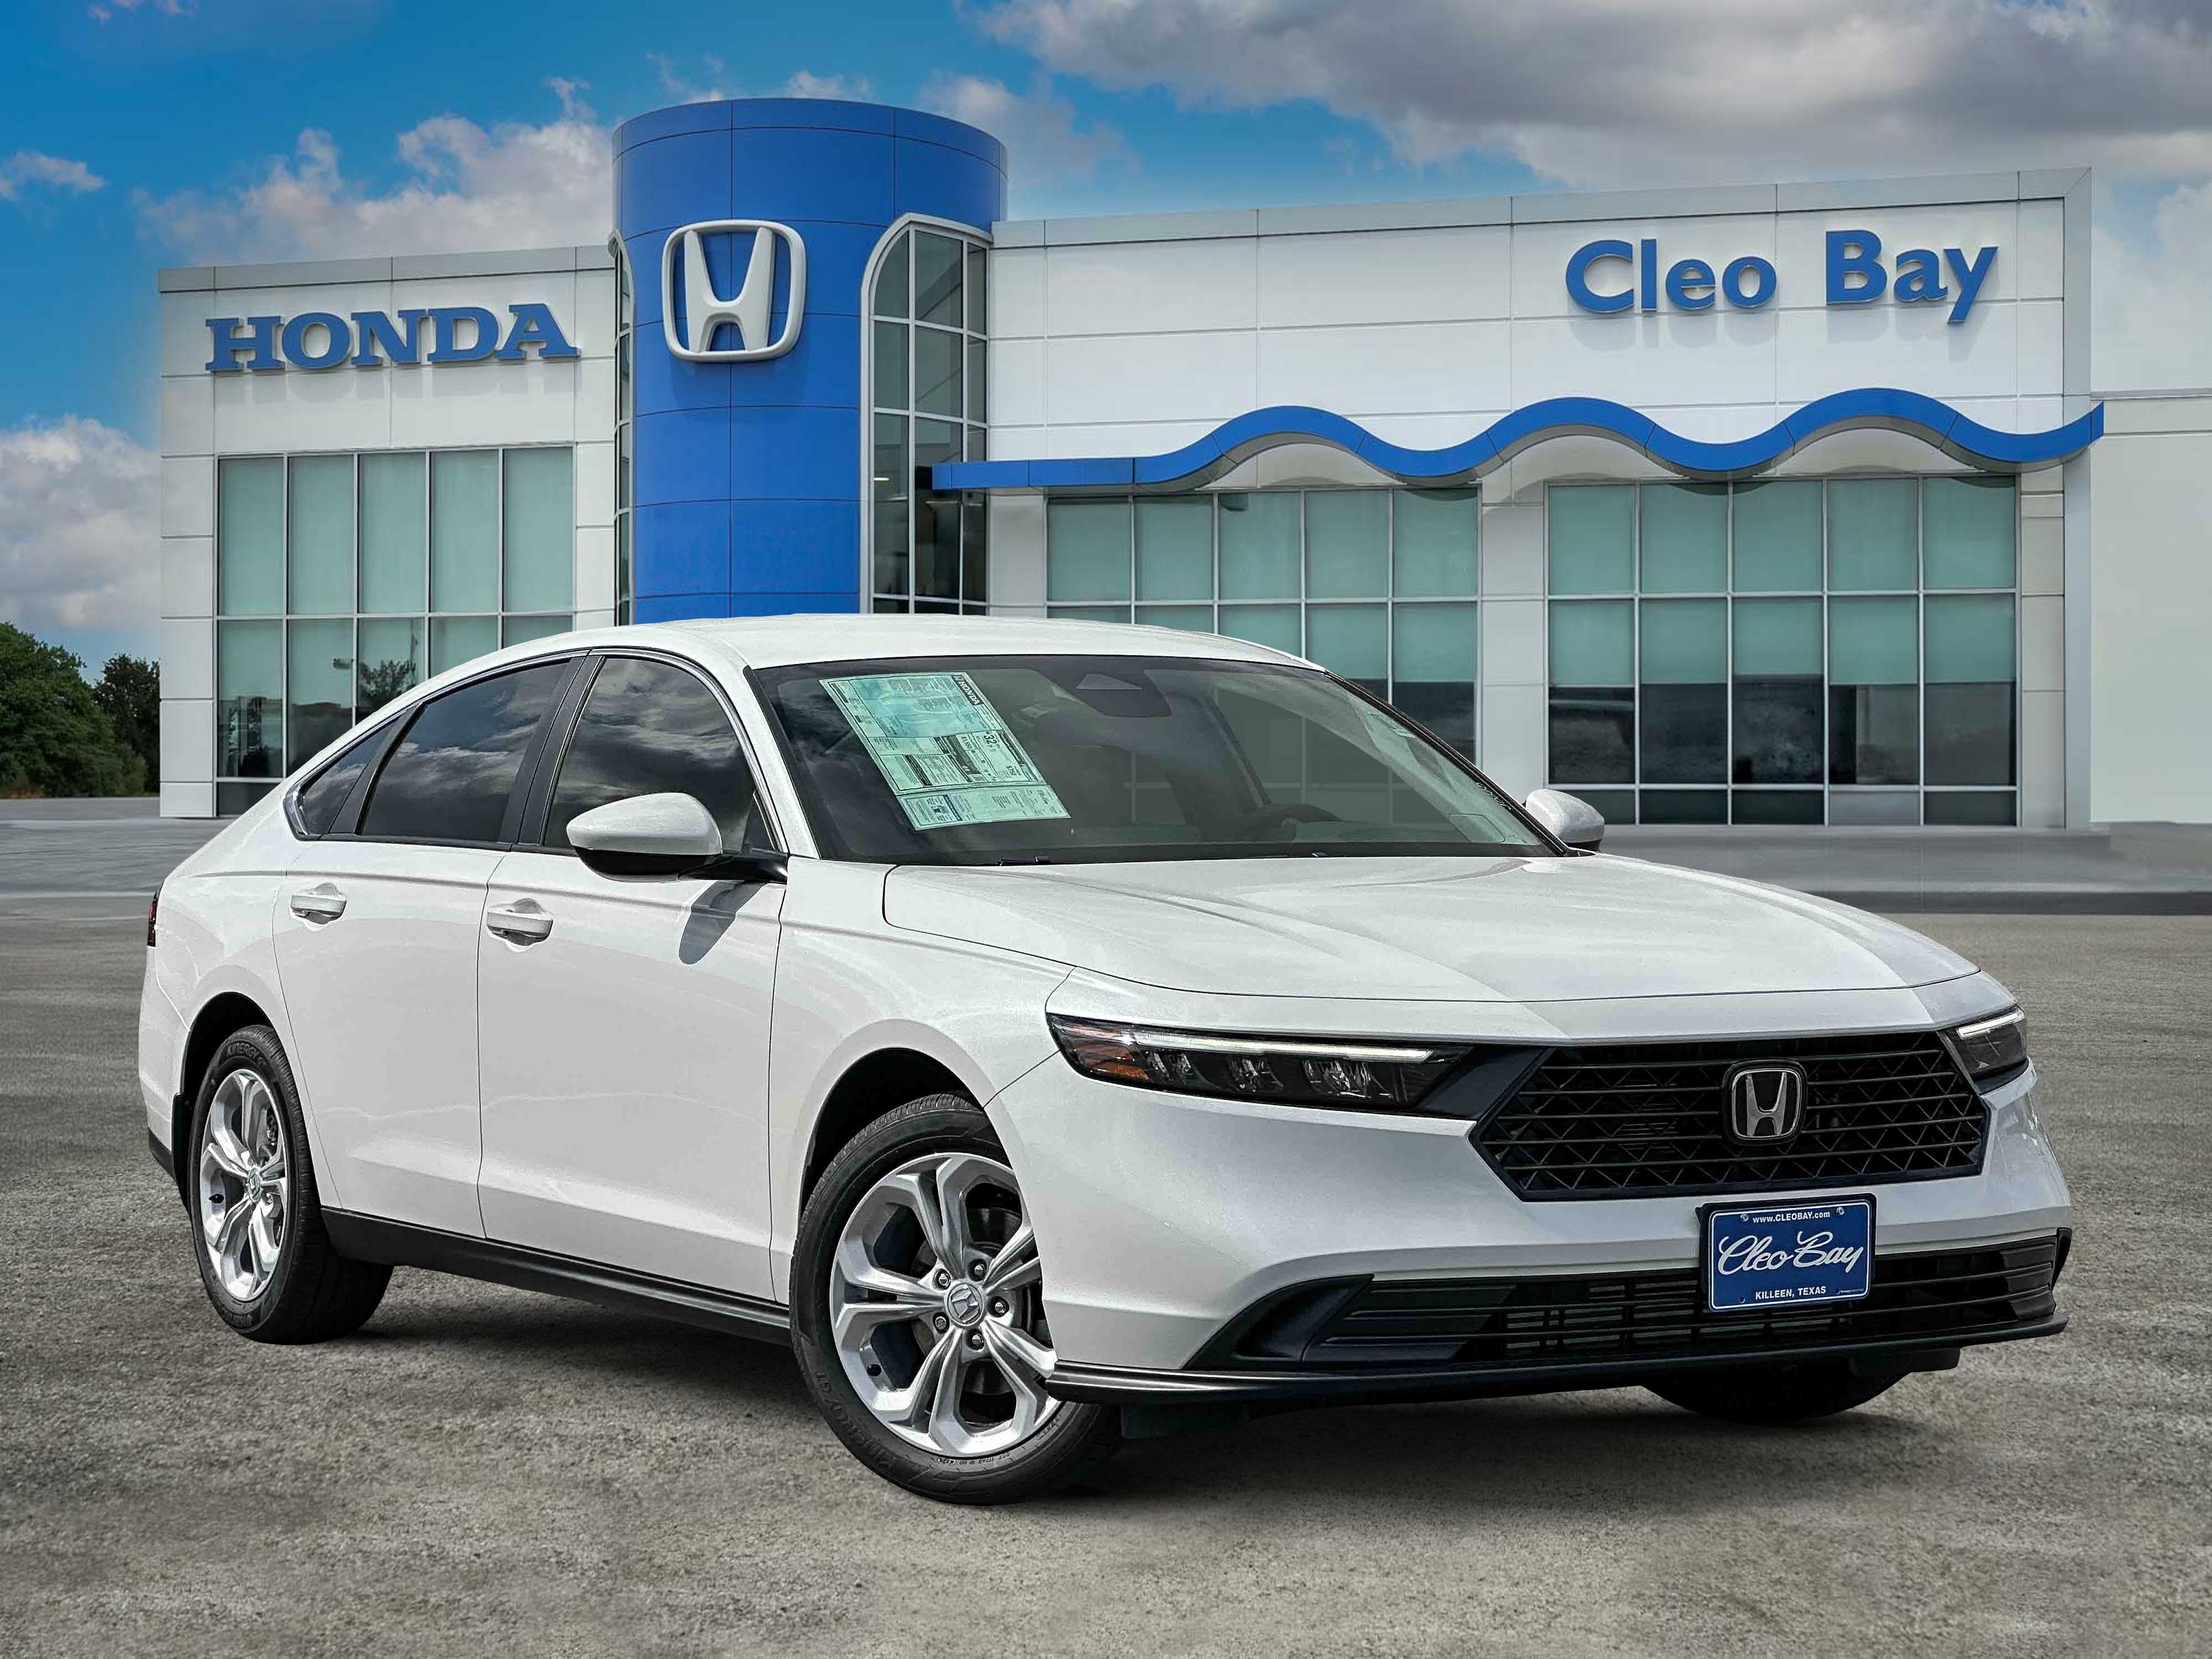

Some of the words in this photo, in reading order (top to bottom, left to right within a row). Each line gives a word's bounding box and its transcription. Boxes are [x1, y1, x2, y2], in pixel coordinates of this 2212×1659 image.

[1565, 238, 1777, 314] Cleo
[1825, 229, 1999, 324] Bay
[205, 303, 582, 373] HONDA
[959, 677, 980, 706] HONDA
[984, 735, 998, 744] 32
[1752, 1211, 1830, 1223] www.CLEOBAY.com
[1718, 1235, 1793, 1275] Cleo
[1793, 1231, 1864, 1273] Bay
[1756, 1288, 1795, 1300] KILLEEN,
[1798, 1286, 1826, 1296] TEXAS
